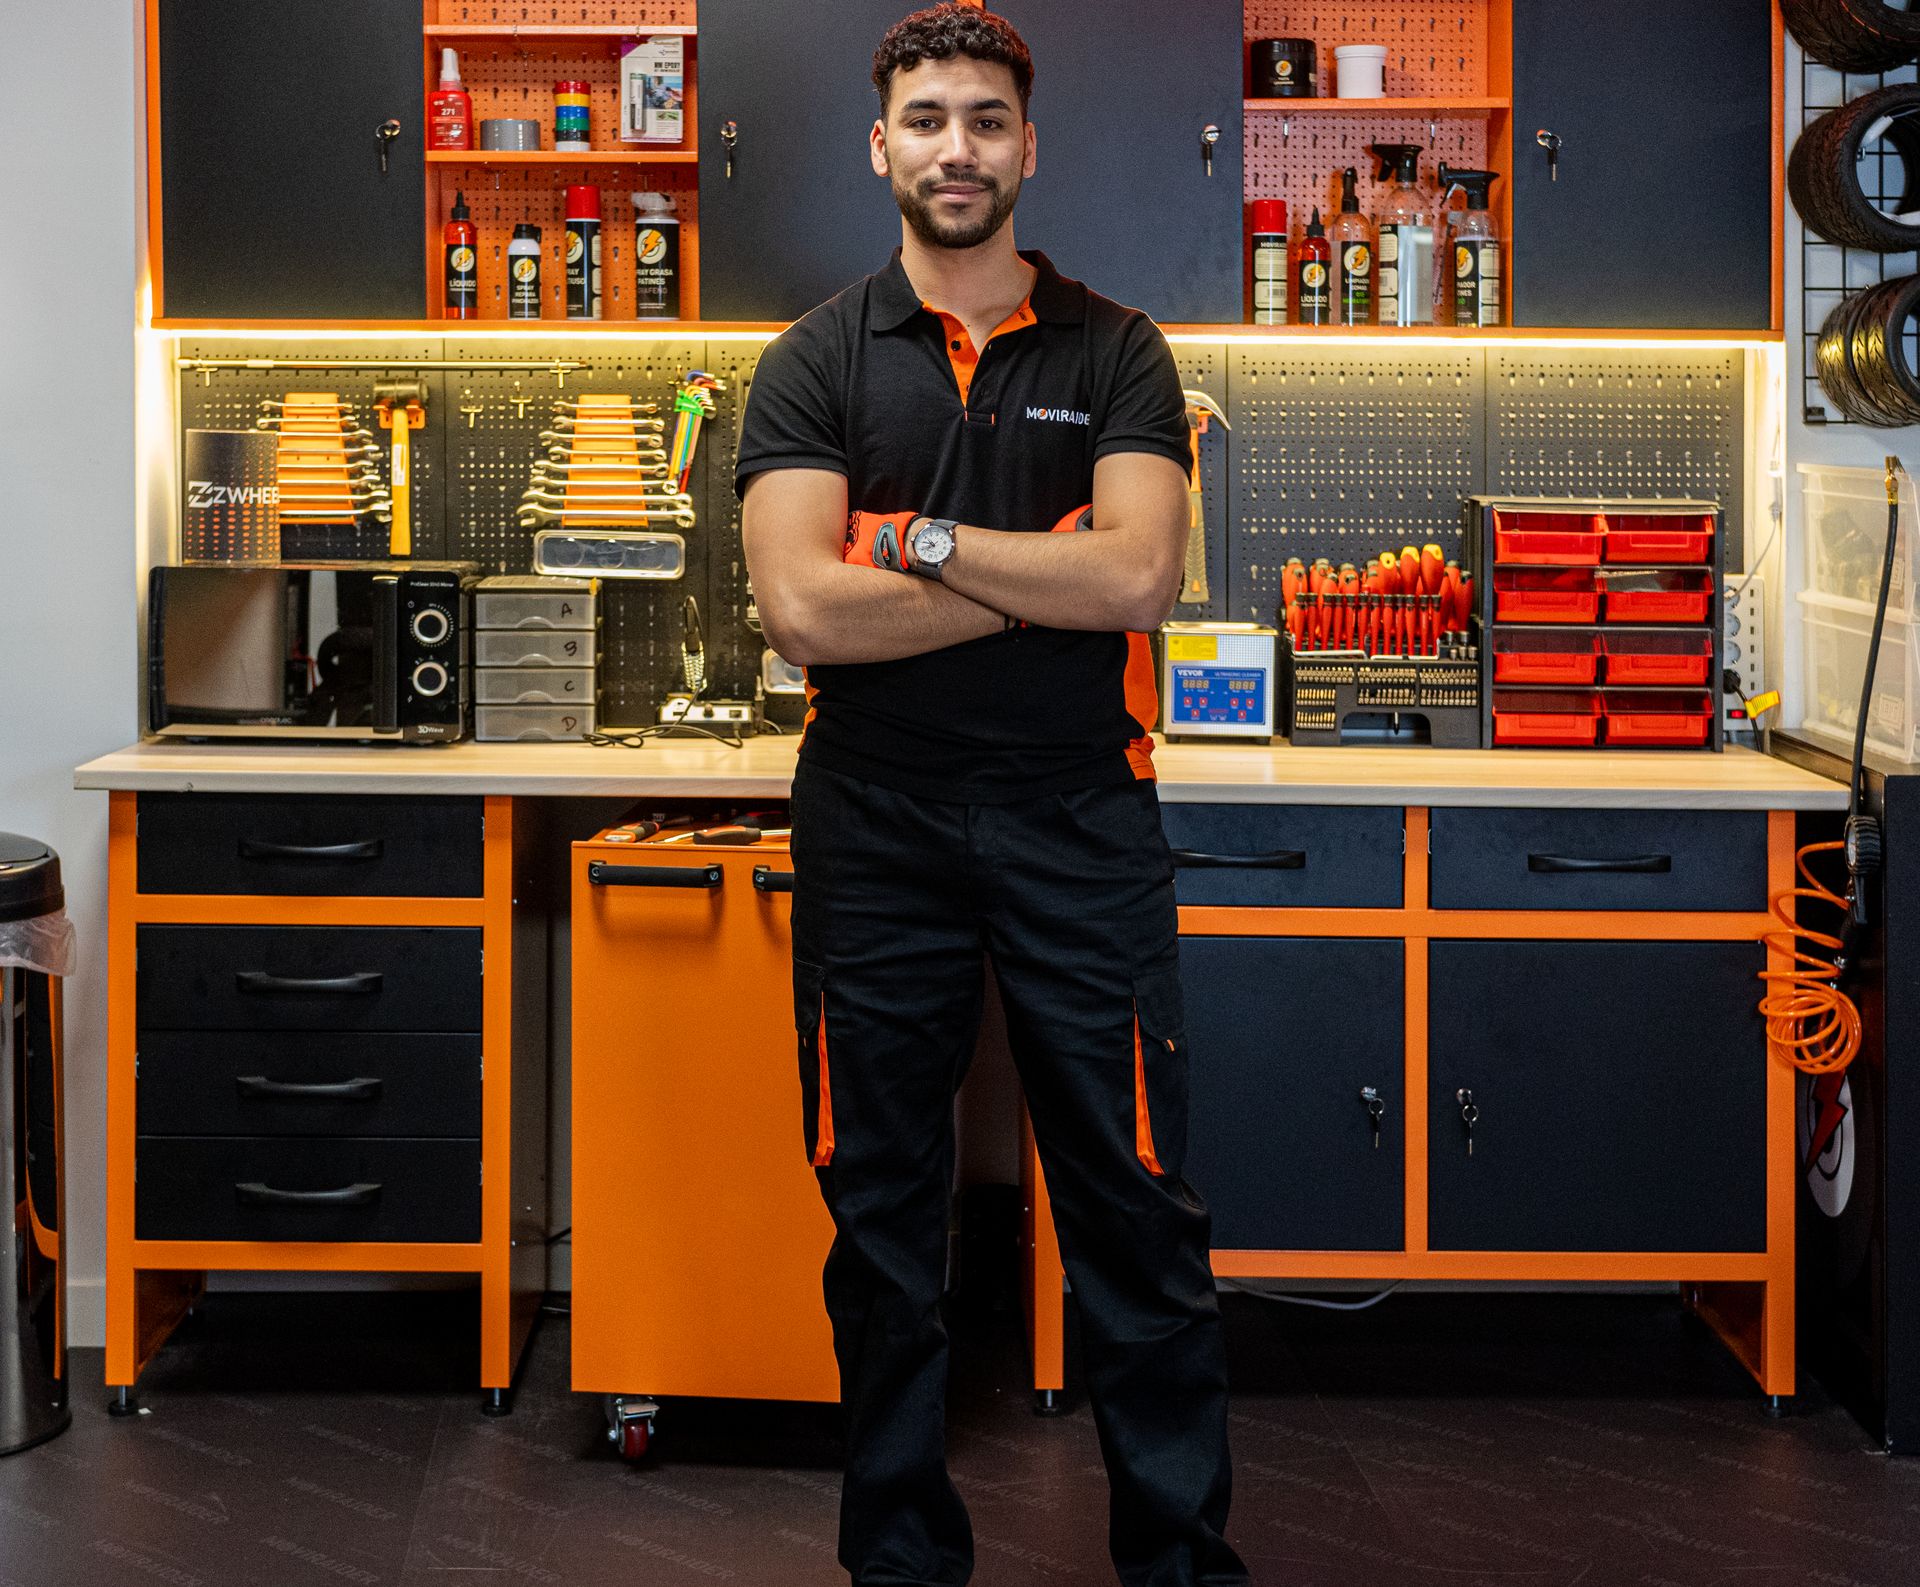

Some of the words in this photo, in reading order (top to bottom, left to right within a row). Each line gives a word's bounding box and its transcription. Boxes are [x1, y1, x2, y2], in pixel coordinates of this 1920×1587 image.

[441, 108, 456, 116] 271
[1026, 406, 1091, 426] MOVIRAIDE
[561, 602, 573, 619] A
[1177, 669, 1204, 677] VEVOR
[564, 680, 575, 692] C
[561, 715, 577, 732] D
